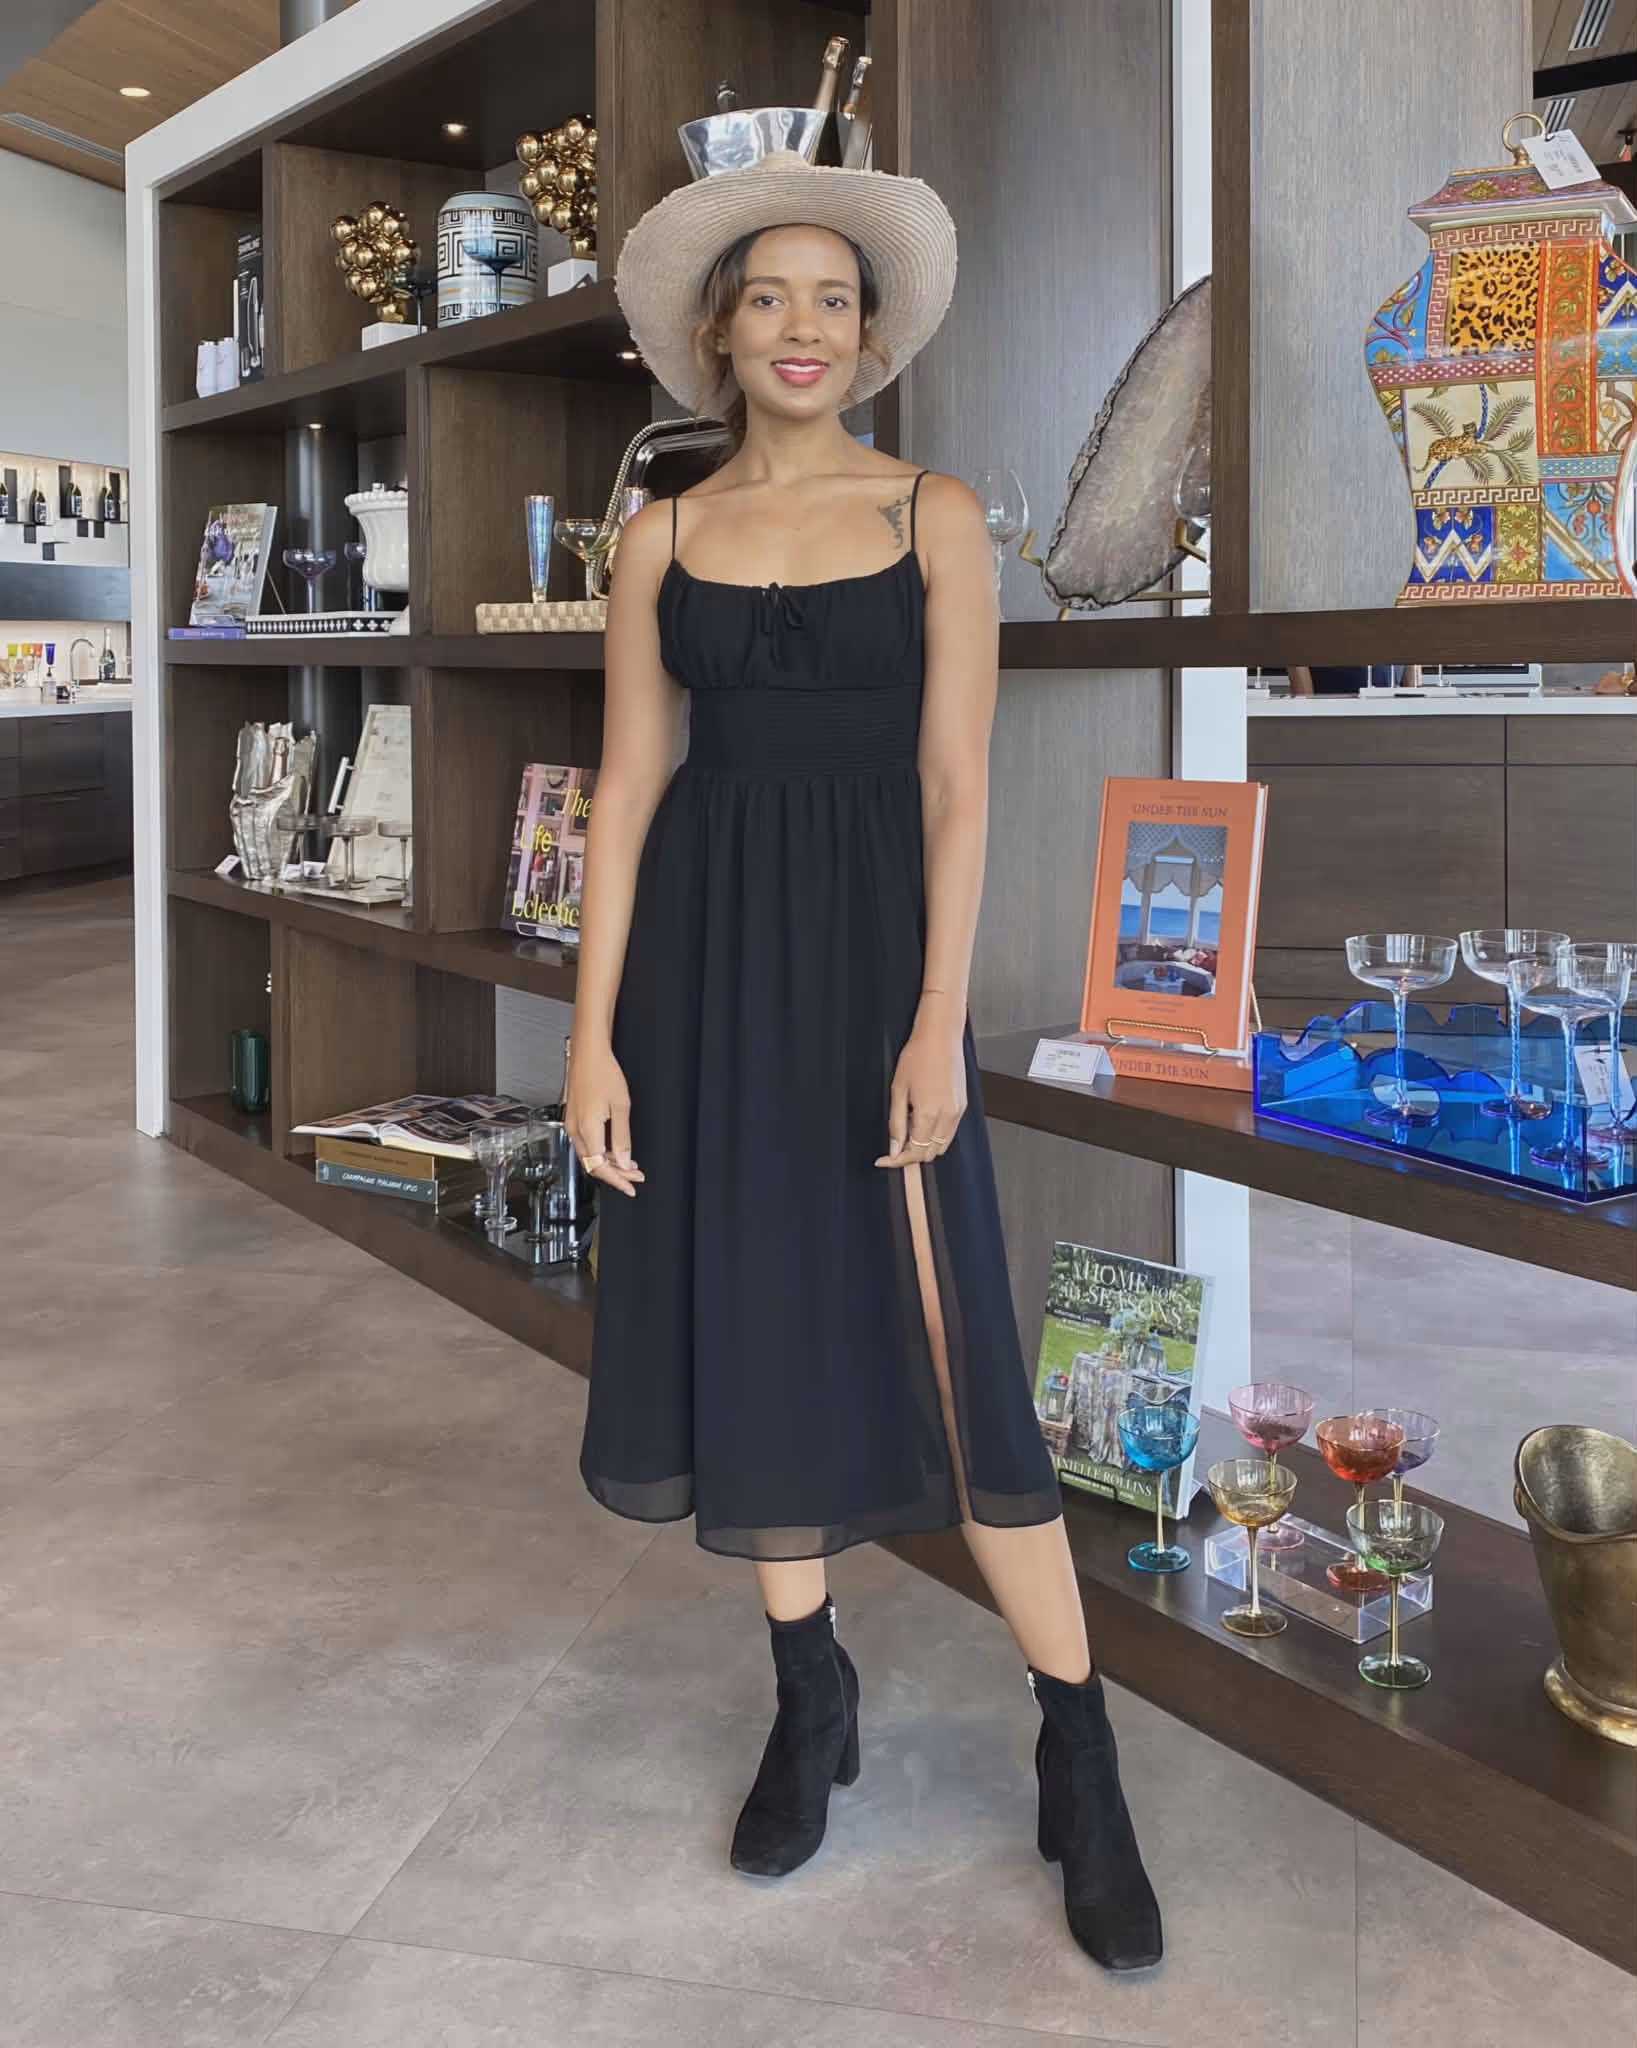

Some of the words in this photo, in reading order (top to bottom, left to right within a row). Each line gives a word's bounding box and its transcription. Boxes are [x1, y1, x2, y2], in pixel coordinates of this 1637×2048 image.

[560, 788, 592, 818] The
[1133, 803, 1171, 816] UNDER
[1176, 805, 1199, 817] THE
[1201, 806, 1228, 818] SUN
[519, 823, 553, 853] Life
[511, 890, 580, 928] Eclectic
[1155, 1063, 1178, 1077] THE
[1181, 1066, 1209, 1081] SUN
[1084, 1260, 1148, 1295] HOME
[1087, 1283, 1184, 1331] SEASONS
[1104, 1471, 1152, 1497] ROLLINS
